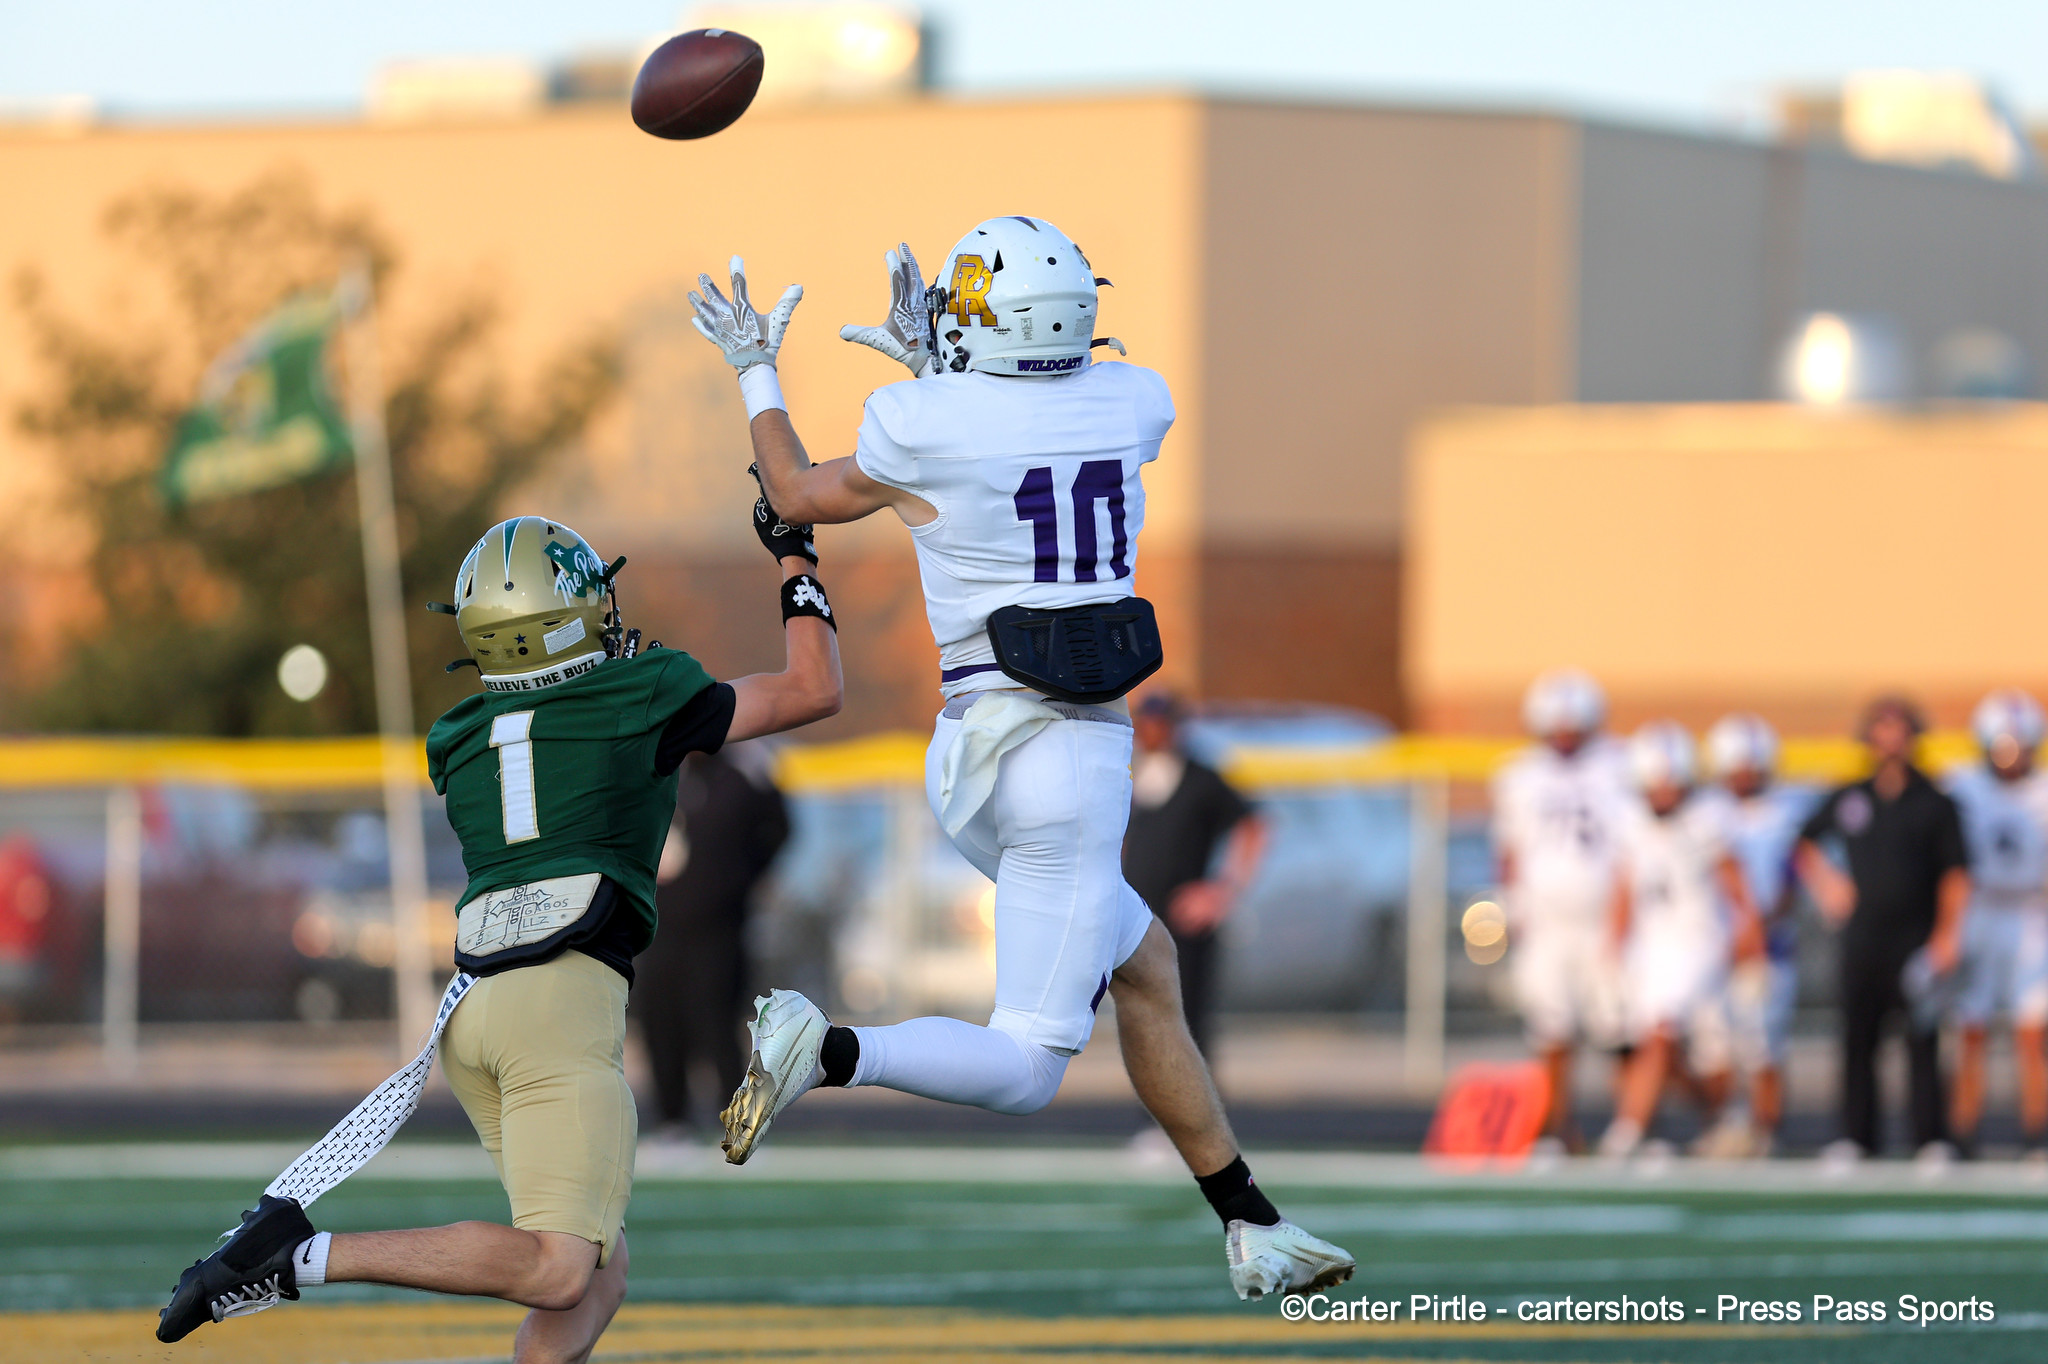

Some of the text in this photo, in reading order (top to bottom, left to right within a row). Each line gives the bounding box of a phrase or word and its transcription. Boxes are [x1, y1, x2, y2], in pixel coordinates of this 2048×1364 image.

[1013, 459, 1130, 583] 10
[554, 568, 582, 607] The
[574, 550, 597, 581] Pa
[532, 672, 561, 688] THE
[562, 658, 598, 679] BUZZ
[488, 709, 541, 845] 1
[514, 886, 525, 901] OD
[510, 906, 521, 925] DID
[525, 898, 569, 915] GABOS
[522, 916, 550, 929] LLZ
